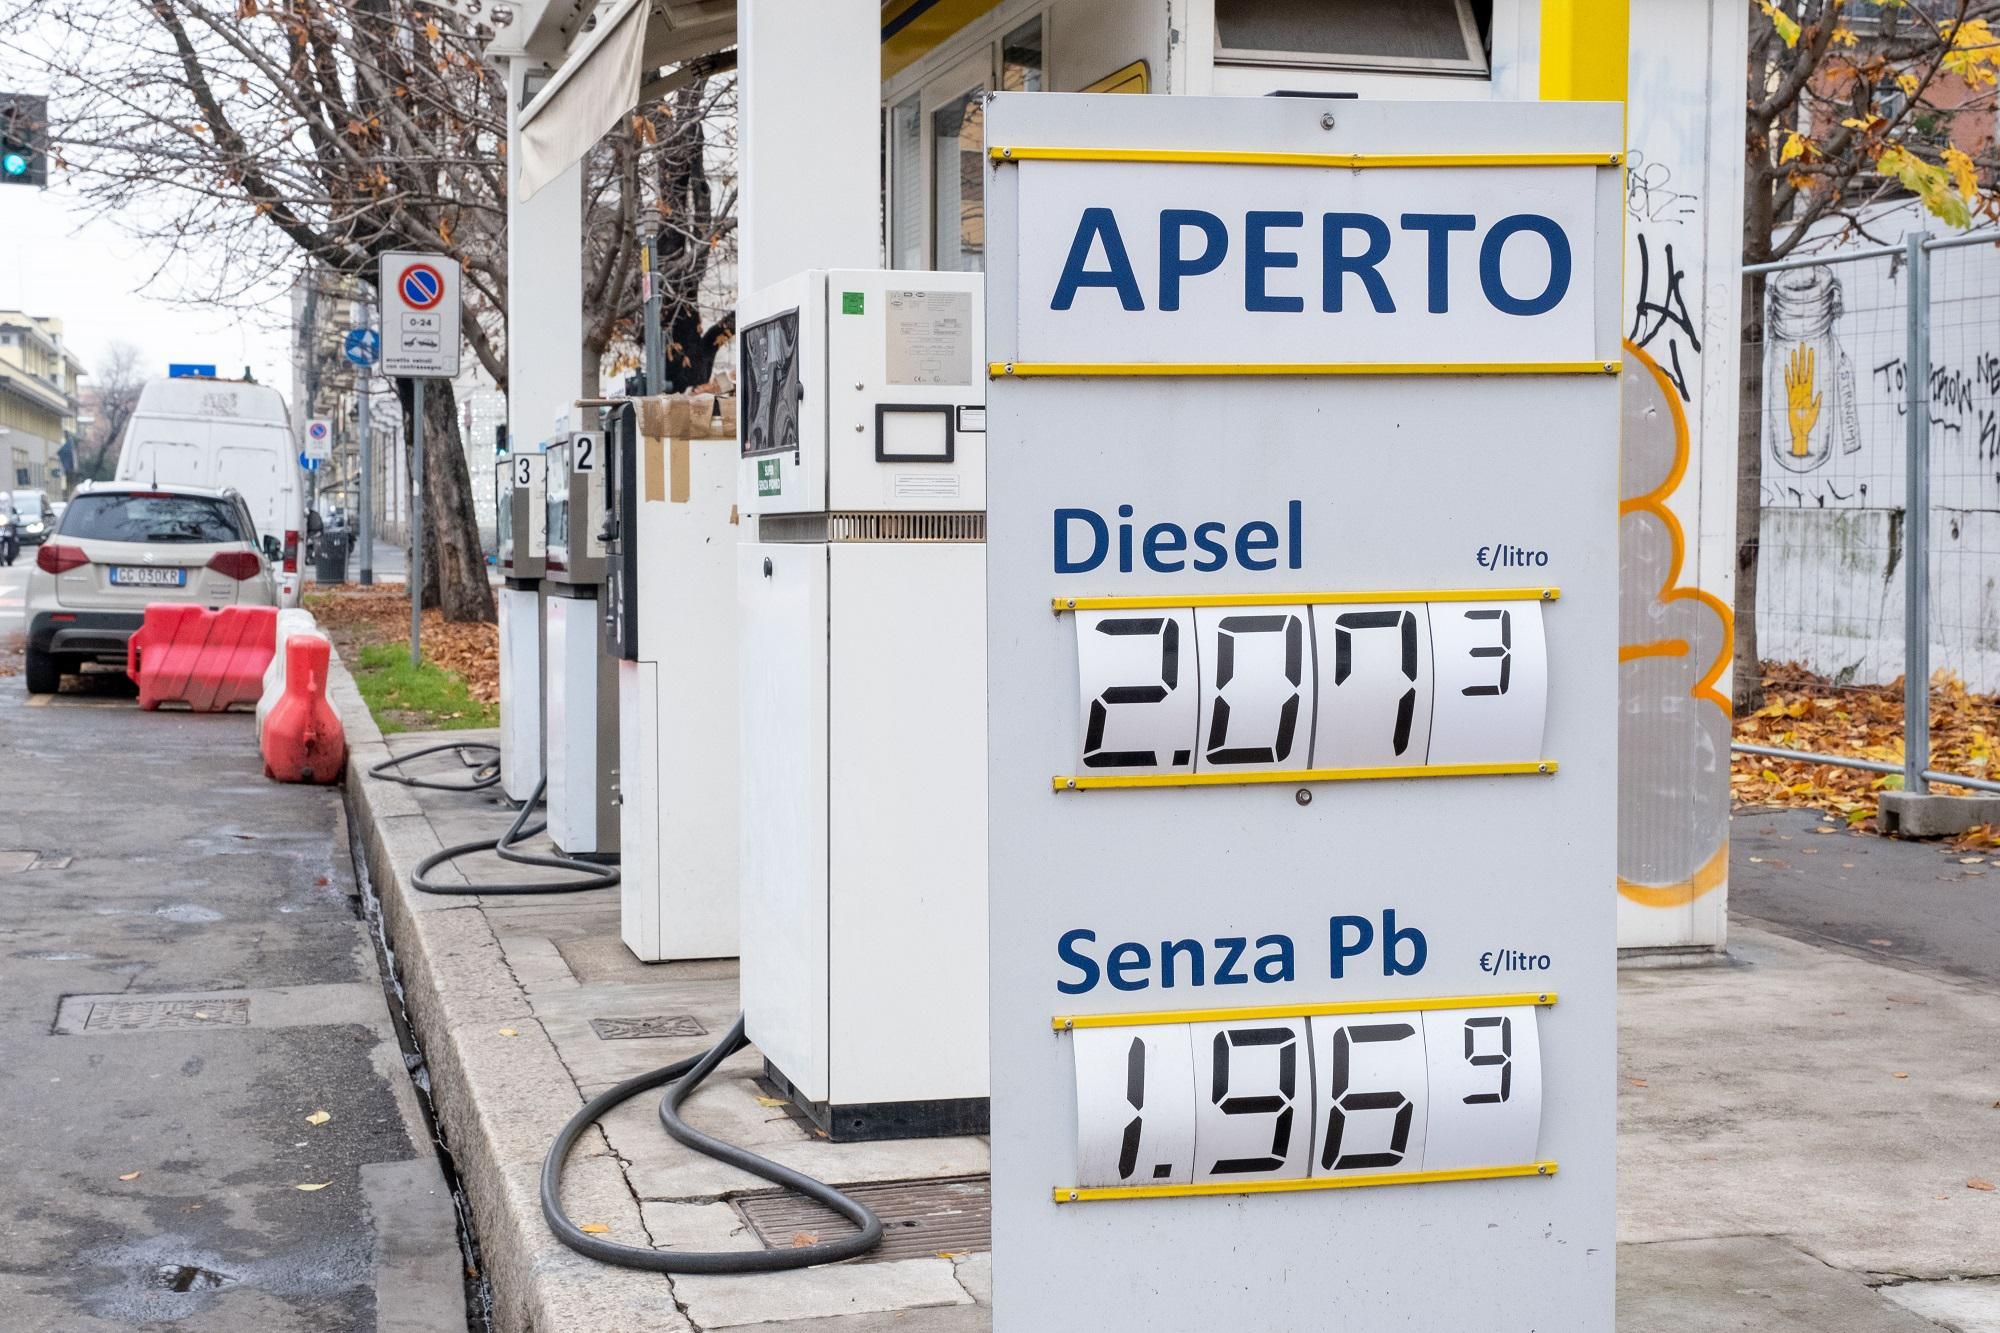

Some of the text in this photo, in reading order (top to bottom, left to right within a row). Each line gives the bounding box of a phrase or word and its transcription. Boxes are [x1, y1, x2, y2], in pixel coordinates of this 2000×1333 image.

[1049, 207, 1572, 316] APERTO
[409, 318, 432, 327] 0-24
[577, 437, 593, 470] 2
[518, 457, 531, 484] 3
[1053, 500, 1302, 574] Diesel
[1476, 544, 1549, 571] €/litro
[1056, 908, 1428, 995] Senza Pb
[1479, 948, 1551, 974] €/litro
